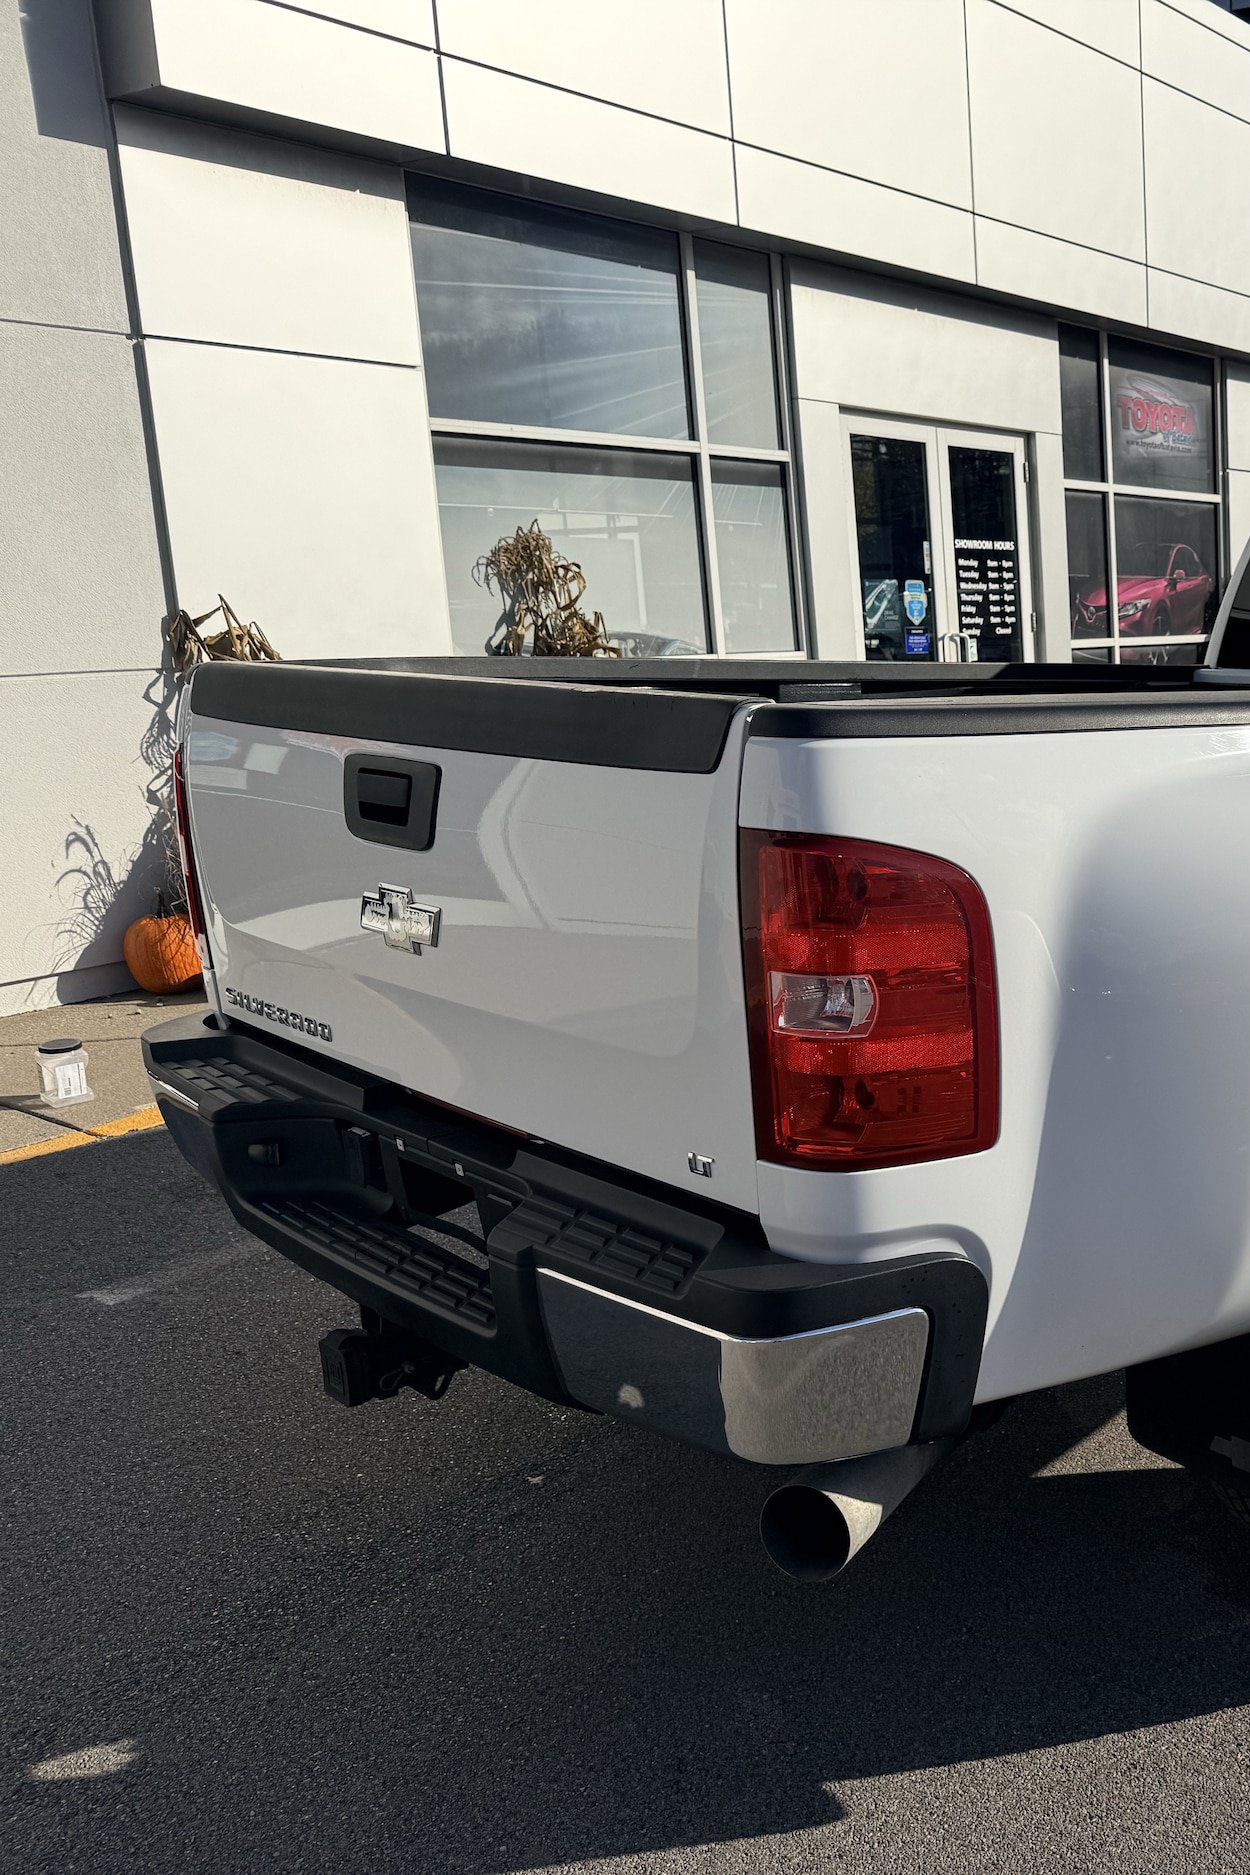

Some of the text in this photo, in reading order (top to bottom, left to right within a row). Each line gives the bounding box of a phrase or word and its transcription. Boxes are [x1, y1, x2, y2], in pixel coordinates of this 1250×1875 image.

[1117, 395, 1195, 435] TOYOTA
[954, 539, 1015, 551] SHOWROOM HOURS
[958, 558, 979, 568] Monday
[959, 570, 979, 579] Tuesday
[960, 582, 987, 591] Wednesday
[960, 593, 983, 602] Thursday
[961, 605, 976, 614] Friday
[962, 616, 984, 625] Saturday
[962, 626, 1012, 636] Sunday Closed
[225, 987, 333, 1042] SILVERADO
[688, 1151, 715, 1178] LT
